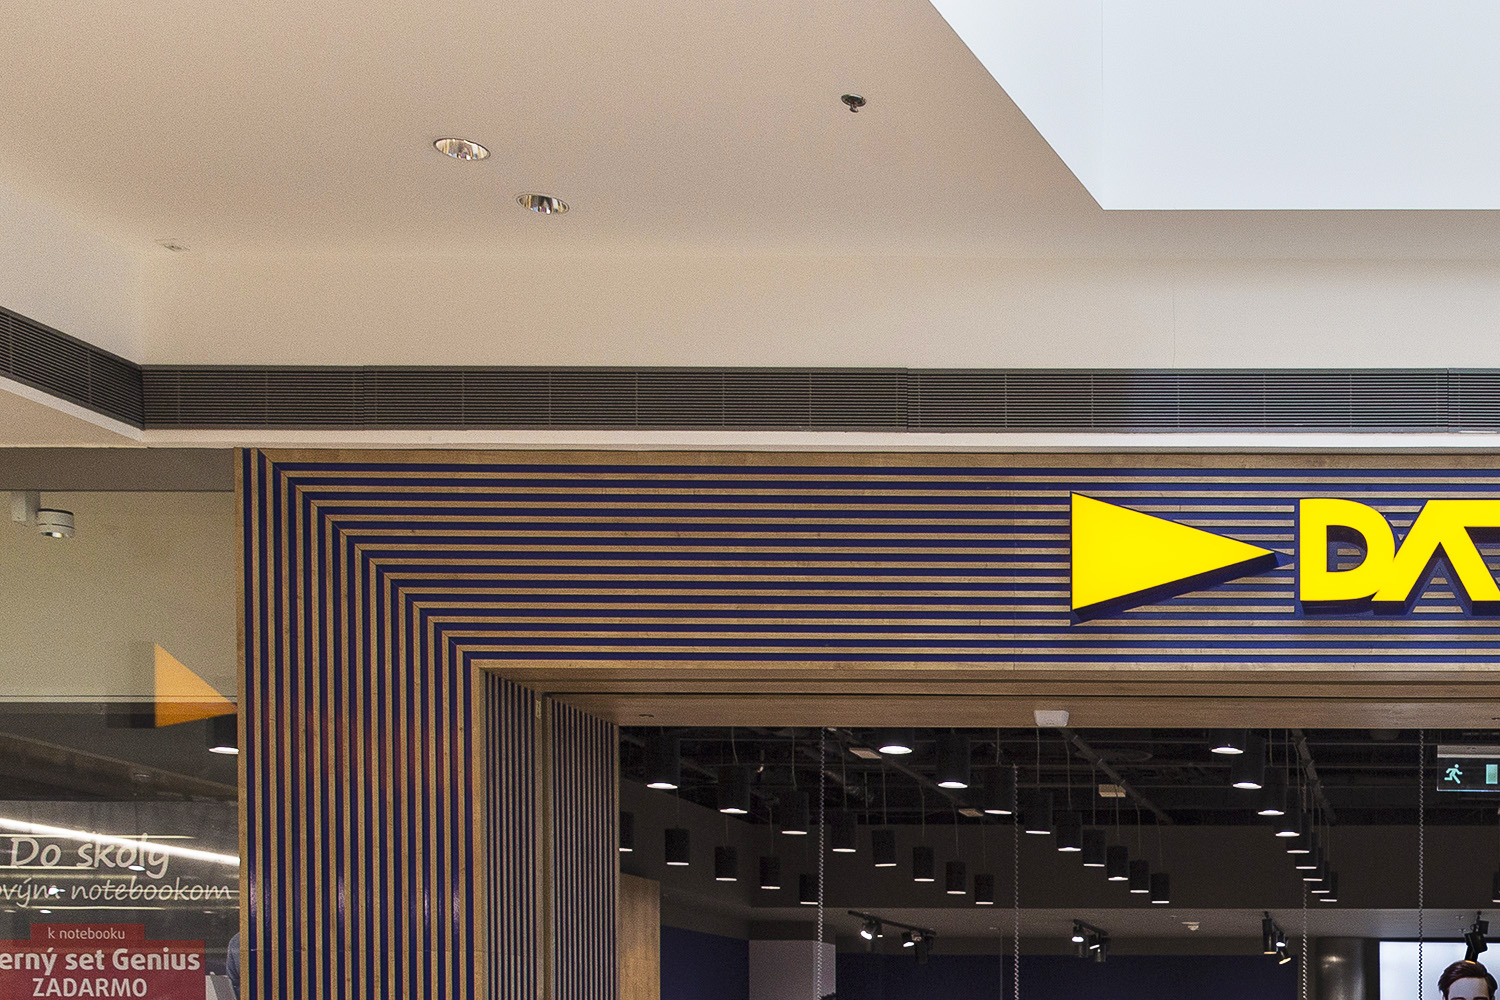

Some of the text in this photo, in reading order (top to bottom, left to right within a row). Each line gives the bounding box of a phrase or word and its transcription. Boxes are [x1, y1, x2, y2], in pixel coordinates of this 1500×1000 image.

[10, 837, 62, 867] Do
[71, 876, 232, 902] notebookom
[48, 927, 125, 940] k notebooku
[0, 947, 201, 976] erný set Genius
[32, 978, 148, 998] ZADARMO
